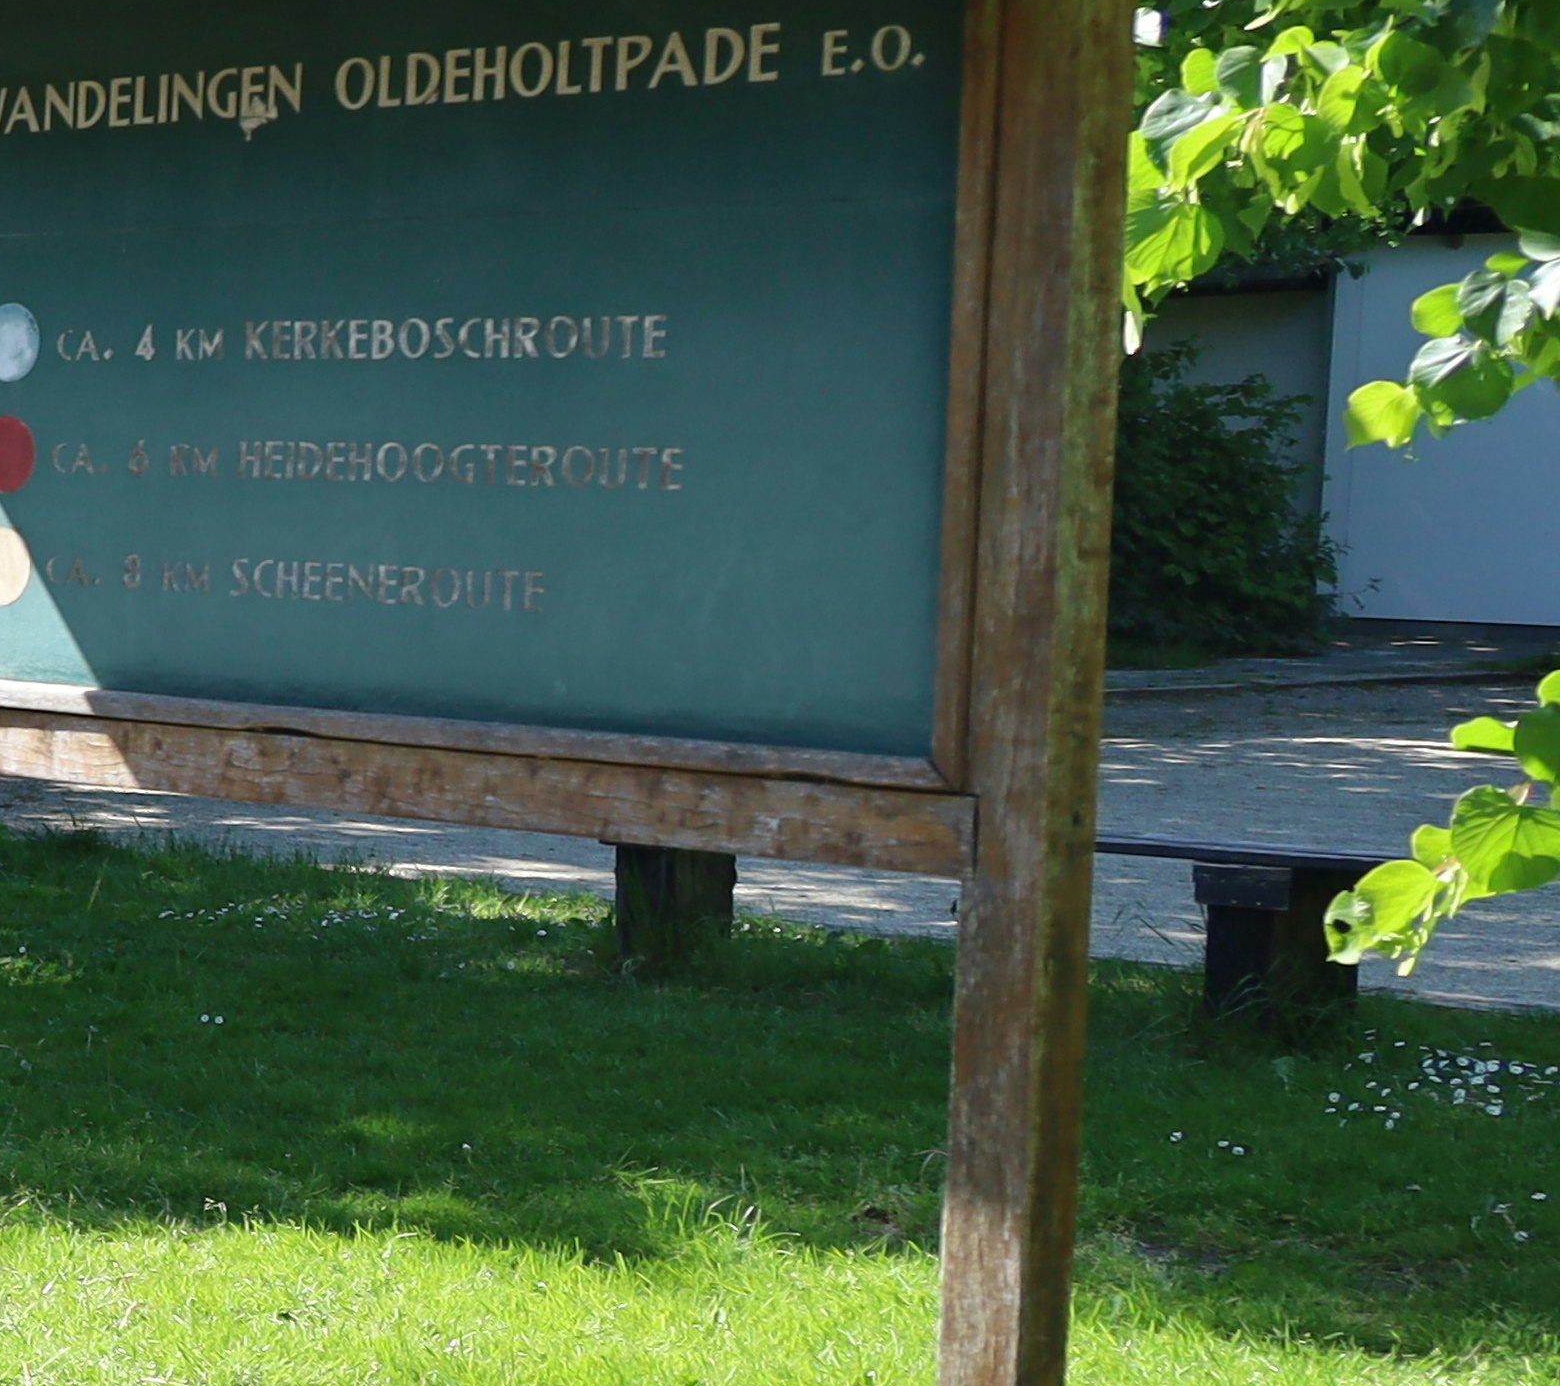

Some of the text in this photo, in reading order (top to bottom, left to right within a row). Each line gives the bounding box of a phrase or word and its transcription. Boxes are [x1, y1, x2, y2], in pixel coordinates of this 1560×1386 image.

[334, 22, 782, 111] OLDEHOLTPADE
[822, 24, 926, 77] E.O.
[56, 314, 668, 362] CA. 4 KM KERKEBOSCHROUTE
[51, 439, 685, 491] CA. 6 KM HEIDEHOOGTEROUTE
[46, 554, 102, 587] CA.
[162, 559, 211, 593] KM
[230, 557, 547, 613] SCHEENEROUTE
